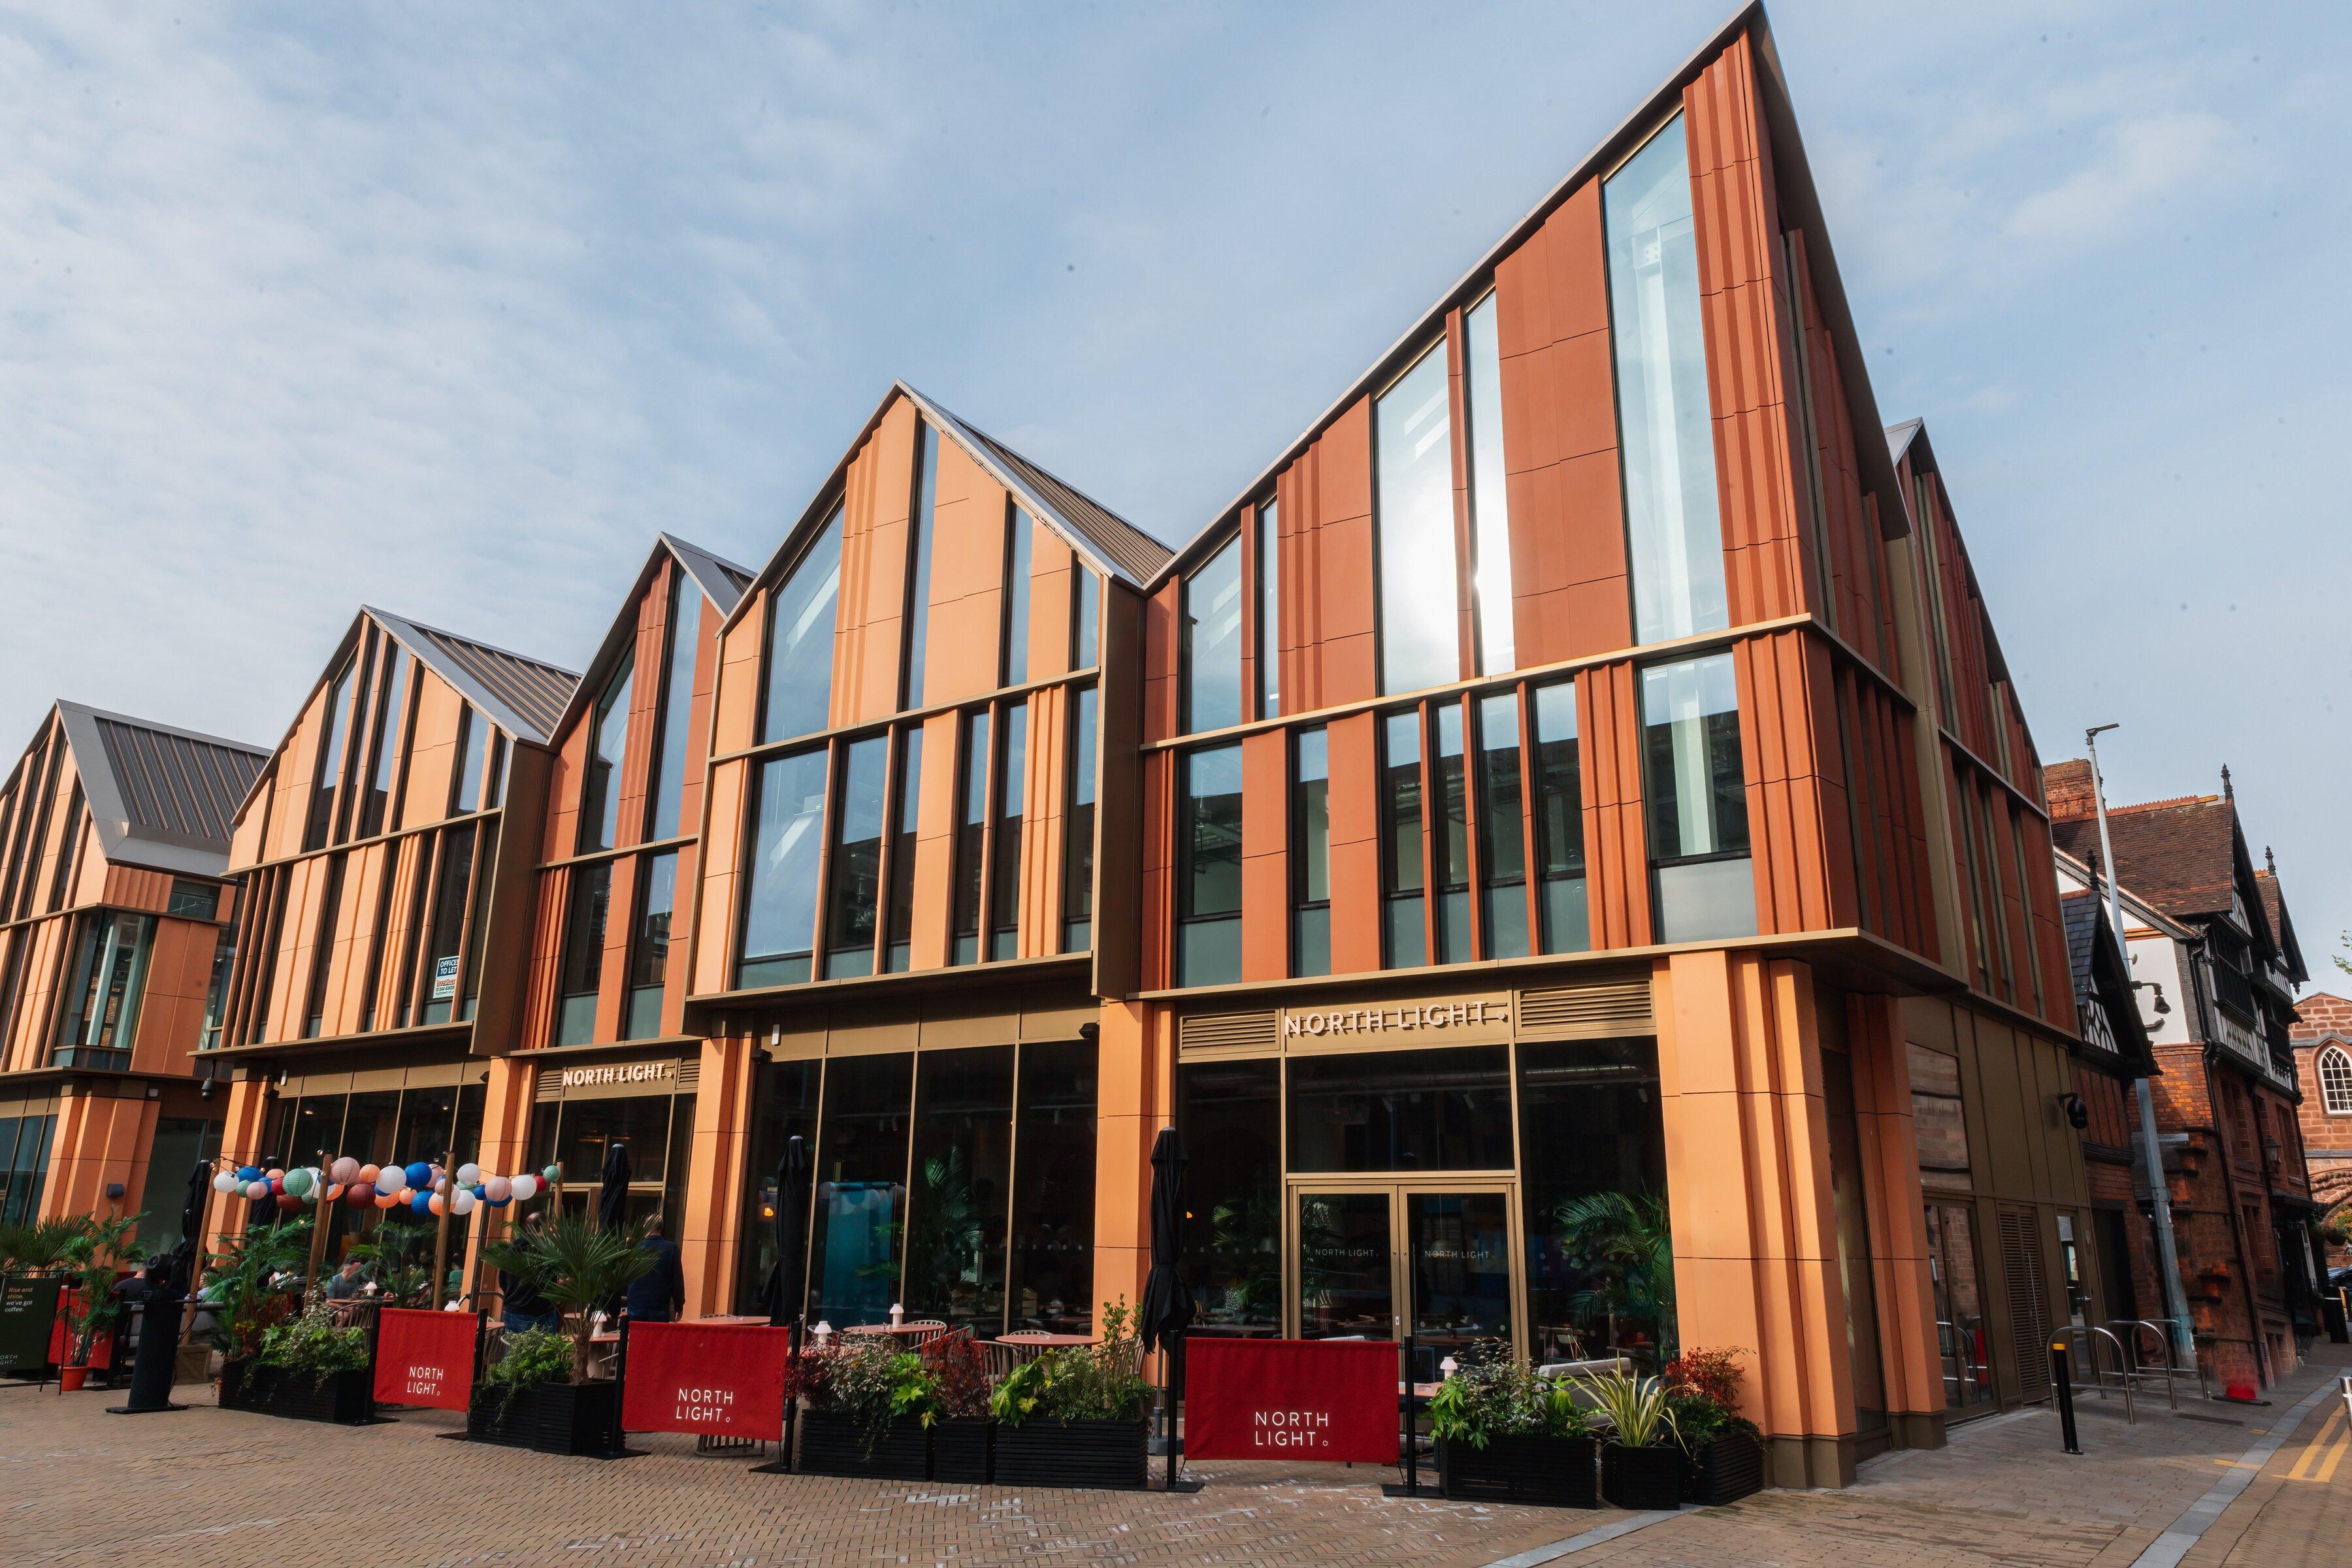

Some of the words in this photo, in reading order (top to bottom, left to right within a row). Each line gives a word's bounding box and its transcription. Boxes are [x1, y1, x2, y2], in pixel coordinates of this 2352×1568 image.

[1284, 1008, 1383, 1035] NORTH
[563, 1067, 614, 1086] NORTH
[1425, 1250, 1458, 1258] NORTH
[409, 1366, 444, 1380] NORTH
[678, 1388, 733, 1405] NORTH
[1255, 1411, 1328, 1427] NORTH
